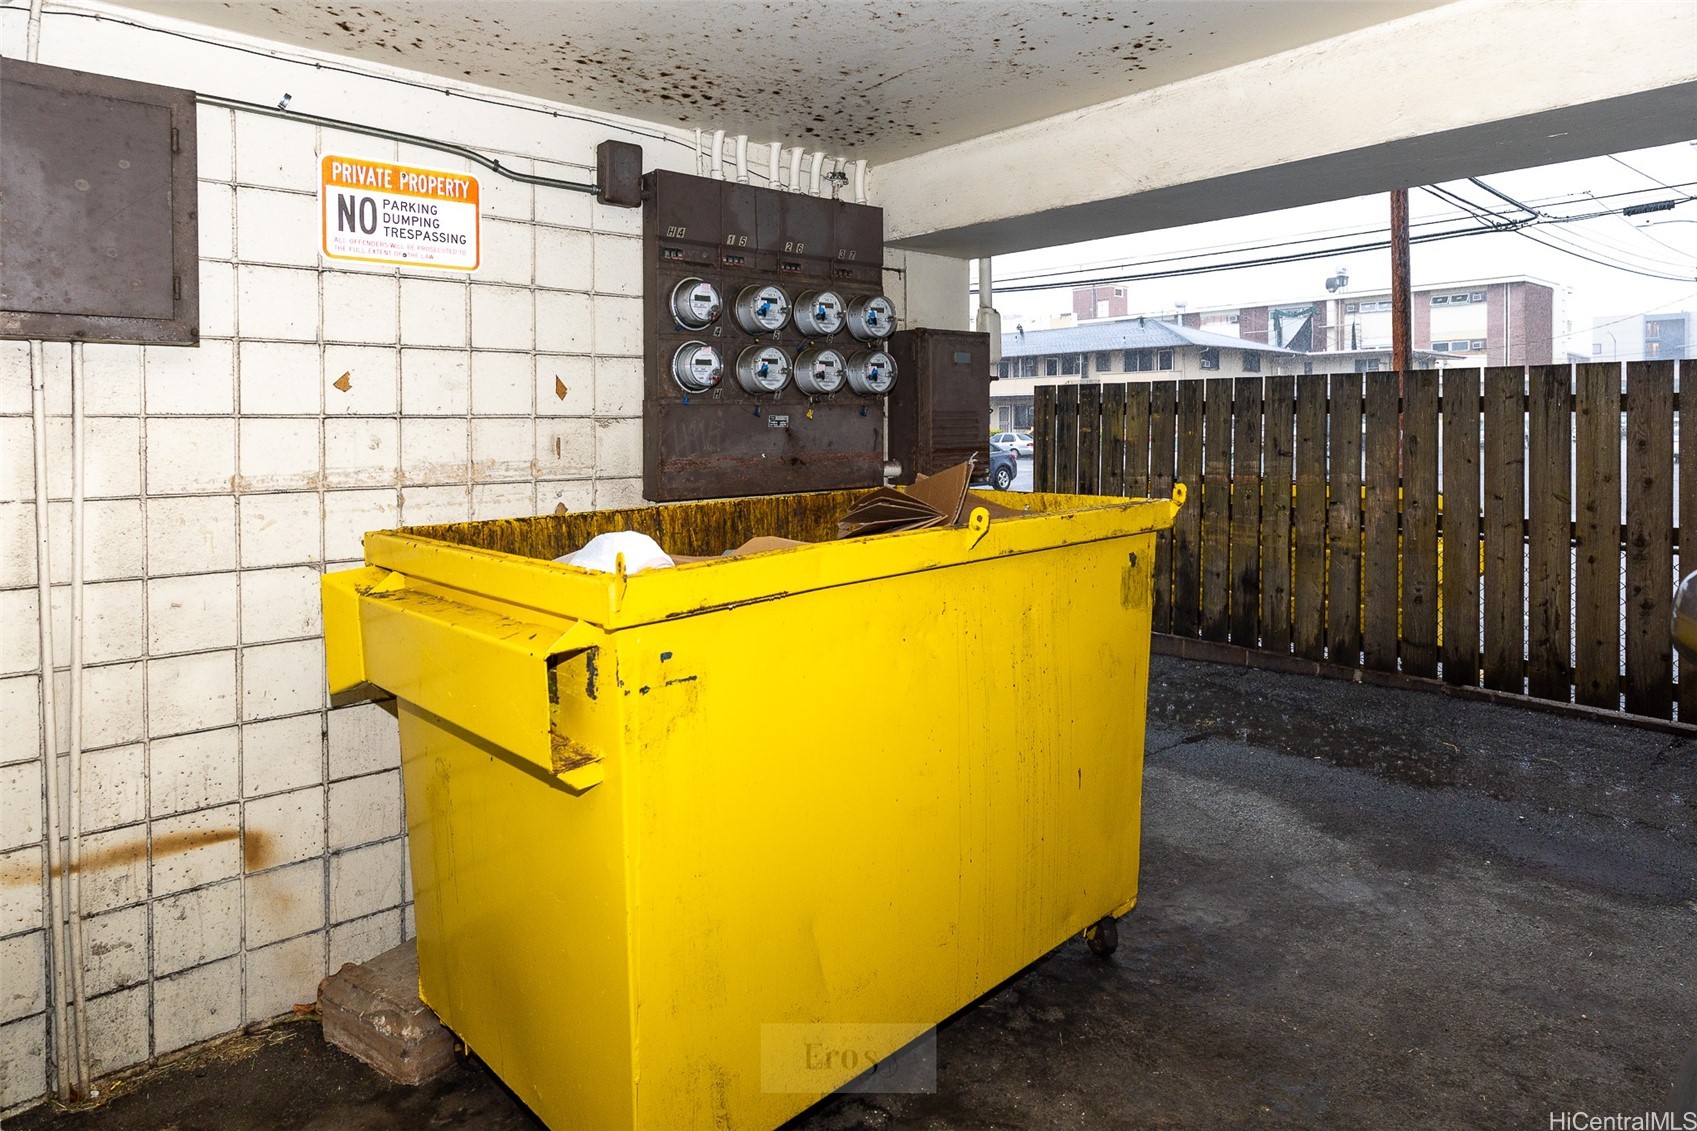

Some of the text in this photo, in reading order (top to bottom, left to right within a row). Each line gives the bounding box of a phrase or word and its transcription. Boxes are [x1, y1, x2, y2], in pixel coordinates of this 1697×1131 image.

[332, 161, 470, 199] PRIVATE PROPERTY
[337, 193, 378, 235] NO
[383, 199, 438, 216] PARKING
[383, 213, 440, 229] DUMPING
[384, 227, 467, 245] TRESPASSING
[334, 236, 345, 244] ALL
[349, 238, 389, 248] OFFENDERS
[417, 245, 457, 255] PROSECUTED
[334, 244, 346, 252] THE
[349, 246, 366, 254] FULL
[368, 248, 392, 256] EXTENT
